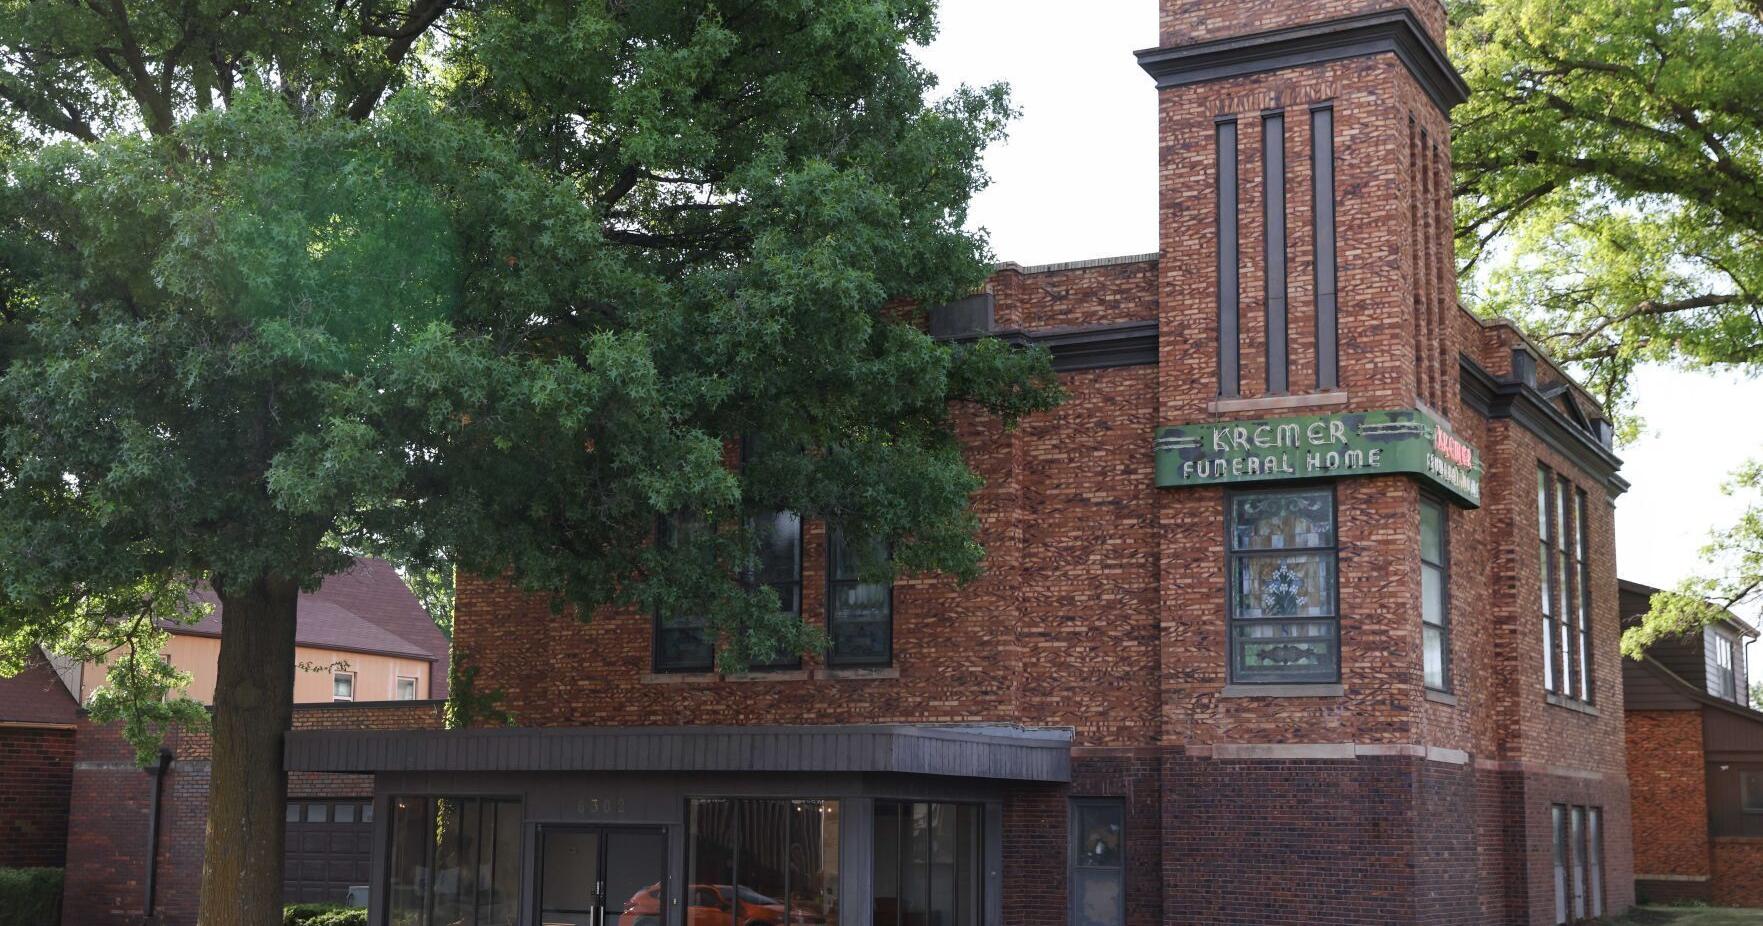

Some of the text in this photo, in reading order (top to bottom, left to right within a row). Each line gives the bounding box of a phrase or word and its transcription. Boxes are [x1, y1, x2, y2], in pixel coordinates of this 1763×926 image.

[1213, 420, 1347, 451] KREMER
[1184, 449, 1382, 479] FUNERAL HOME
